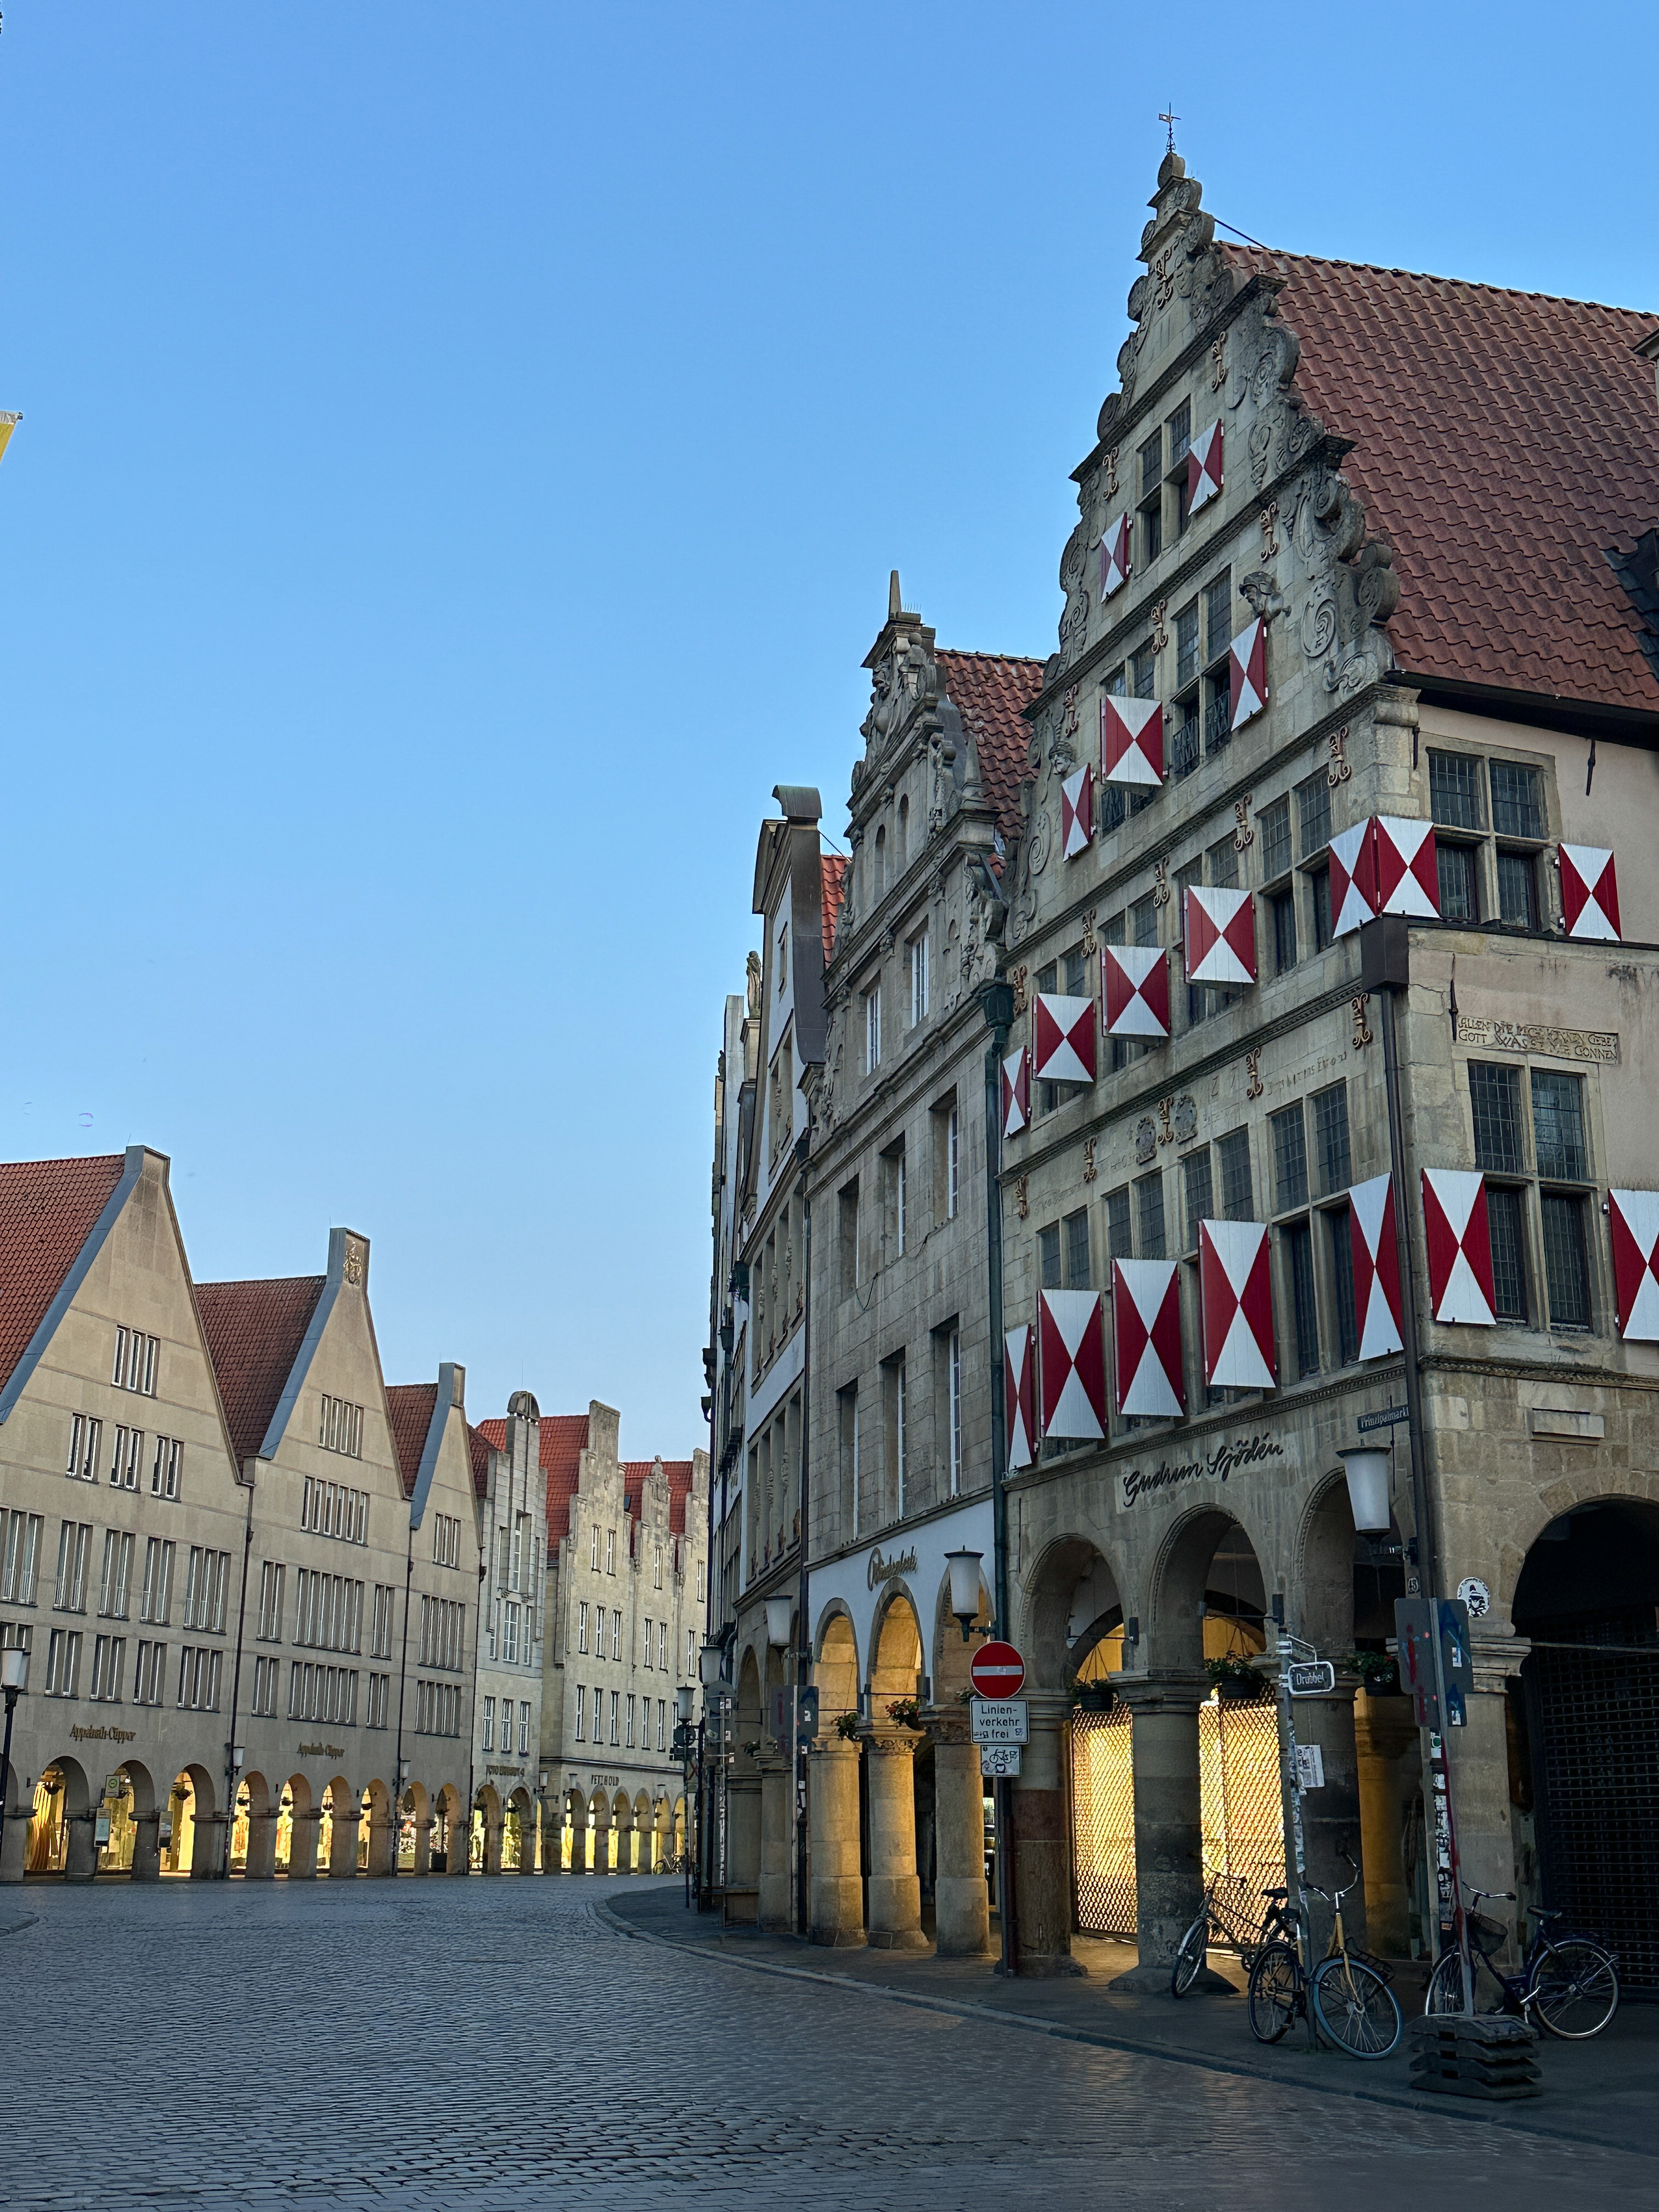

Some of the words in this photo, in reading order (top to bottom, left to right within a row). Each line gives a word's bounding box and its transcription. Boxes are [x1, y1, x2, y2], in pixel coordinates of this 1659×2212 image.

[1459, 1029, 1487, 1043] GOTT
[1124, 1460, 1204, 1508] Gudrun
[981, 1703, 1018, 1714] Linien-
[979, 1717, 1020, 1726] verkehr
[992, 1729, 1009, 1739] frei
